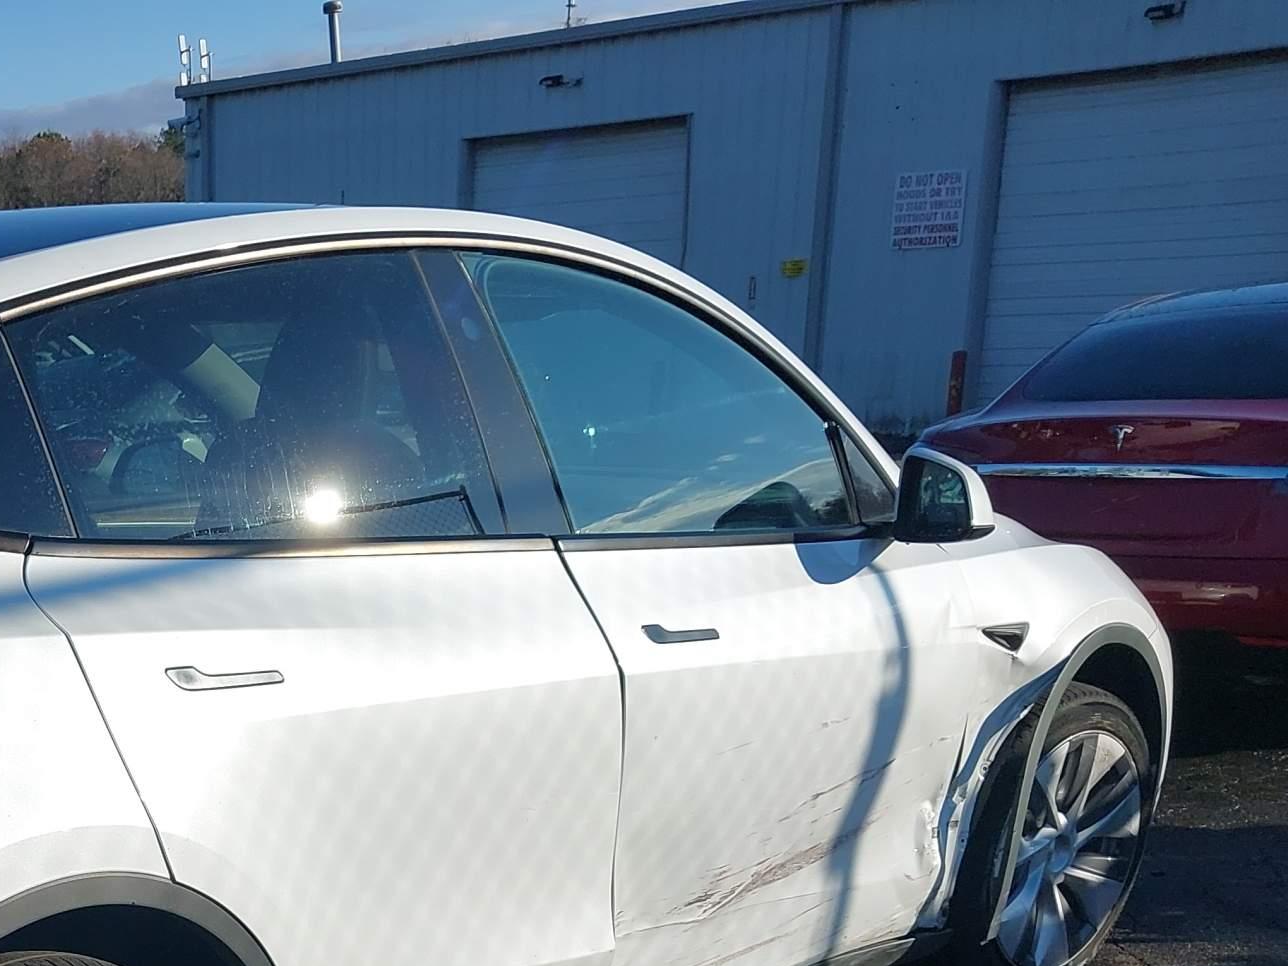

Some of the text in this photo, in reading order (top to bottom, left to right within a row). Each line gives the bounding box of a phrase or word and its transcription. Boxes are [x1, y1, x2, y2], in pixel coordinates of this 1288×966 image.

[899, 172, 962, 189] DO NOT OPEN
[929, 187, 943, 198] OR
[894, 212, 938, 224] WITHOUT
[892, 235, 958, 247] AUTHORIZATION
